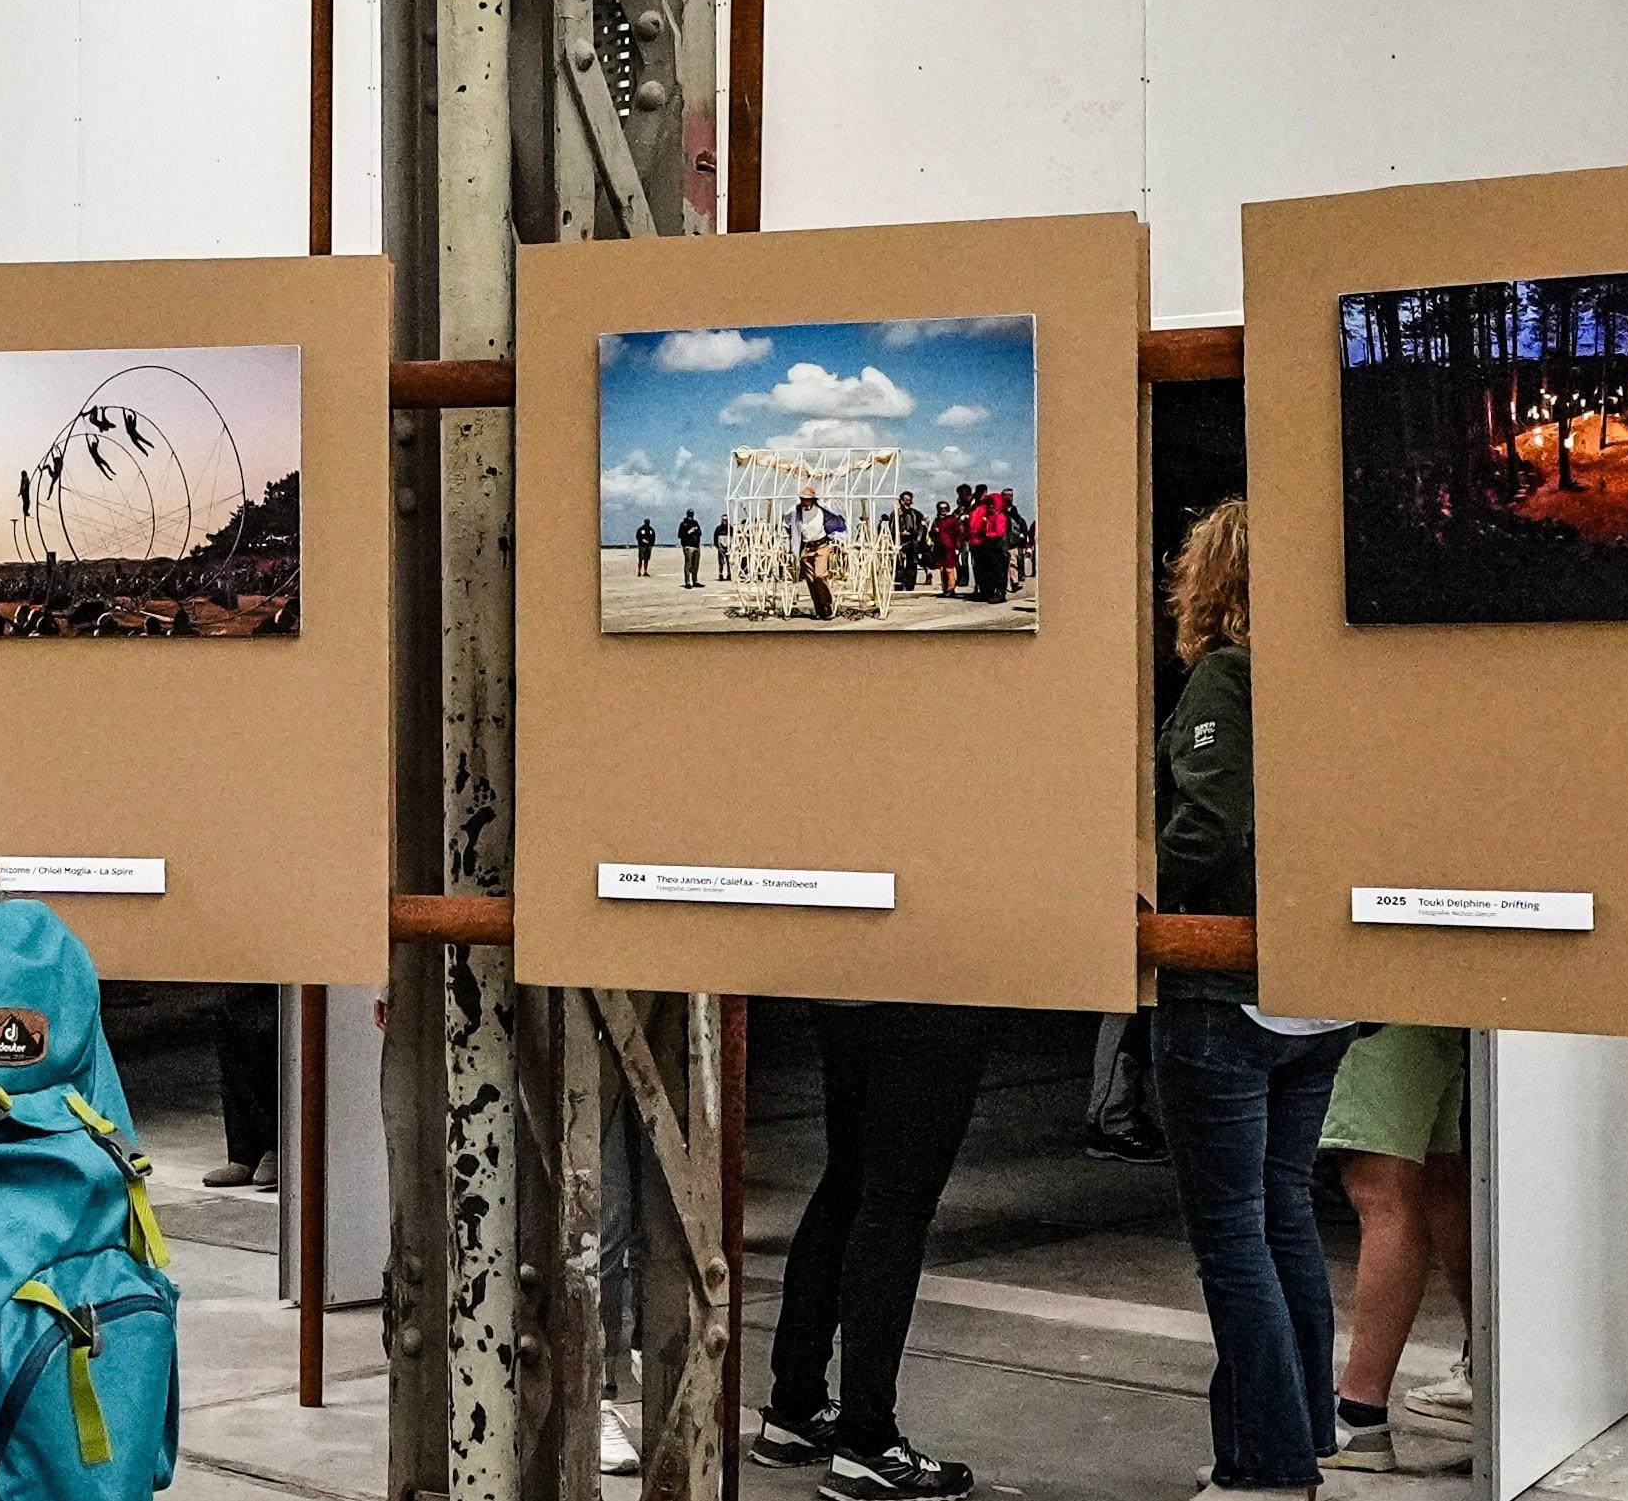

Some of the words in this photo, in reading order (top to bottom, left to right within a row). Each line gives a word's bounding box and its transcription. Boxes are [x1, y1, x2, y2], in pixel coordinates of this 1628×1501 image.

[64, 866, 91, 876] Moglia
[99, 867, 109, 875] La
[111, 867, 133, 876] Spire
[619, 873, 646, 882] 2024
[657, 875, 678, 884] Theo
[680, 875, 711, 885] Jansen
[720, 877, 753, 887] Calefax
[762, 878, 817, 889] Strandbeest
[1376, 896, 1407, 906] 2025
[1418, 898, 1444, 907] Touki
[1447, 898, 1491, 909] Delphine
[1501, 900, 1540, 911] Drifting
